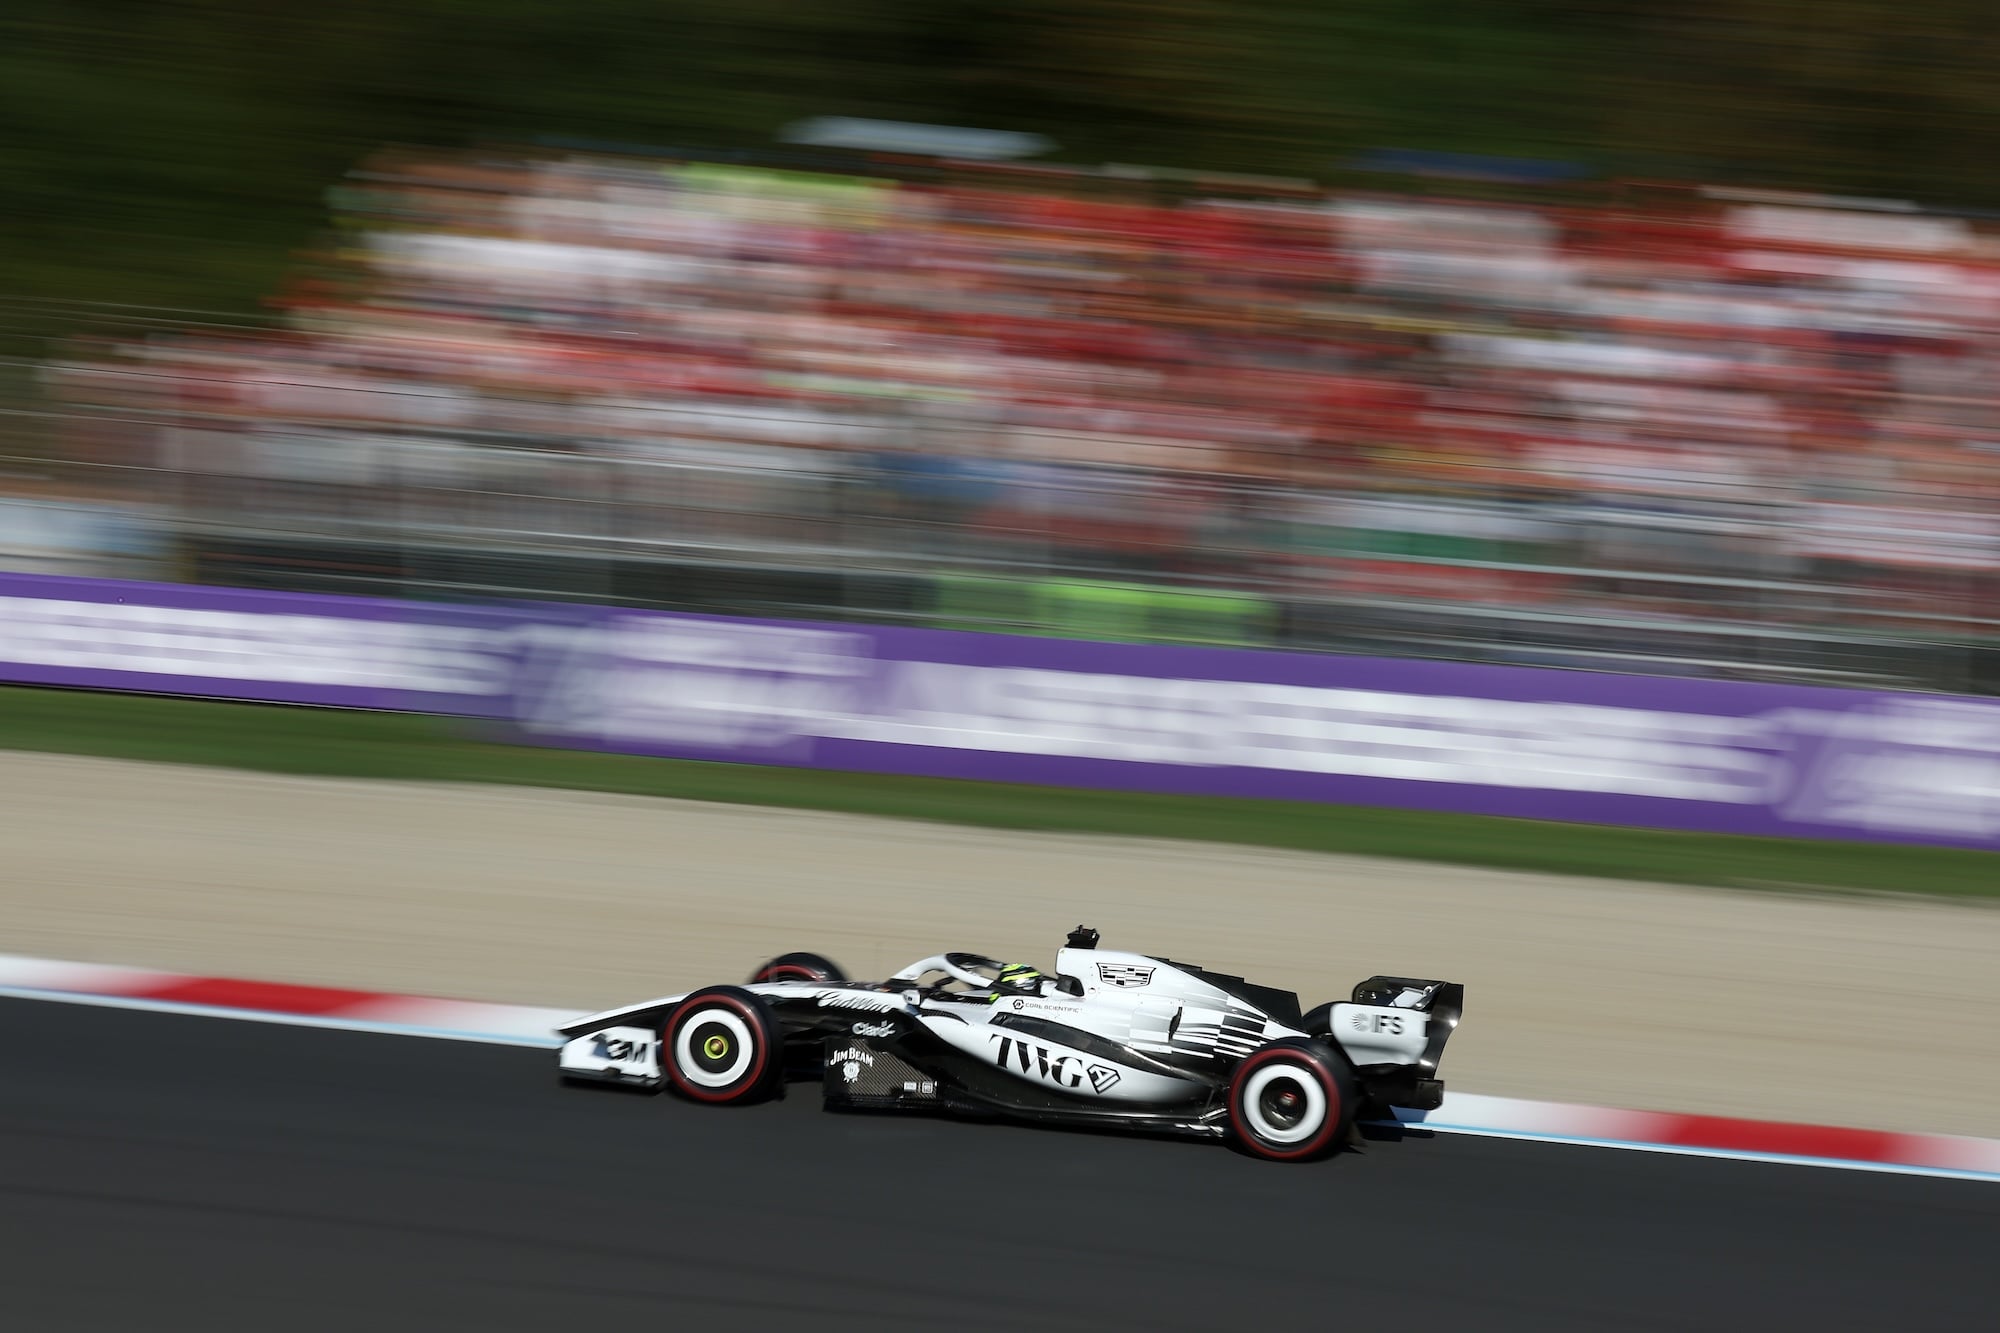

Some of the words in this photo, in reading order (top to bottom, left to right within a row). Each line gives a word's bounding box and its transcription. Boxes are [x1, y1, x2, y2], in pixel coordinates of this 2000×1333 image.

[1025, 1002, 1043, 1010] CORE
[1044, 1004, 1079, 1013] SCIENTIFIC
[1372, 1014, 1404, 1035] IFS
[830, 1050, 848, 1065] JIM
[848, 1047, 873, 1067] BEAM
[989, 1033, 1083, 1088] TWG
